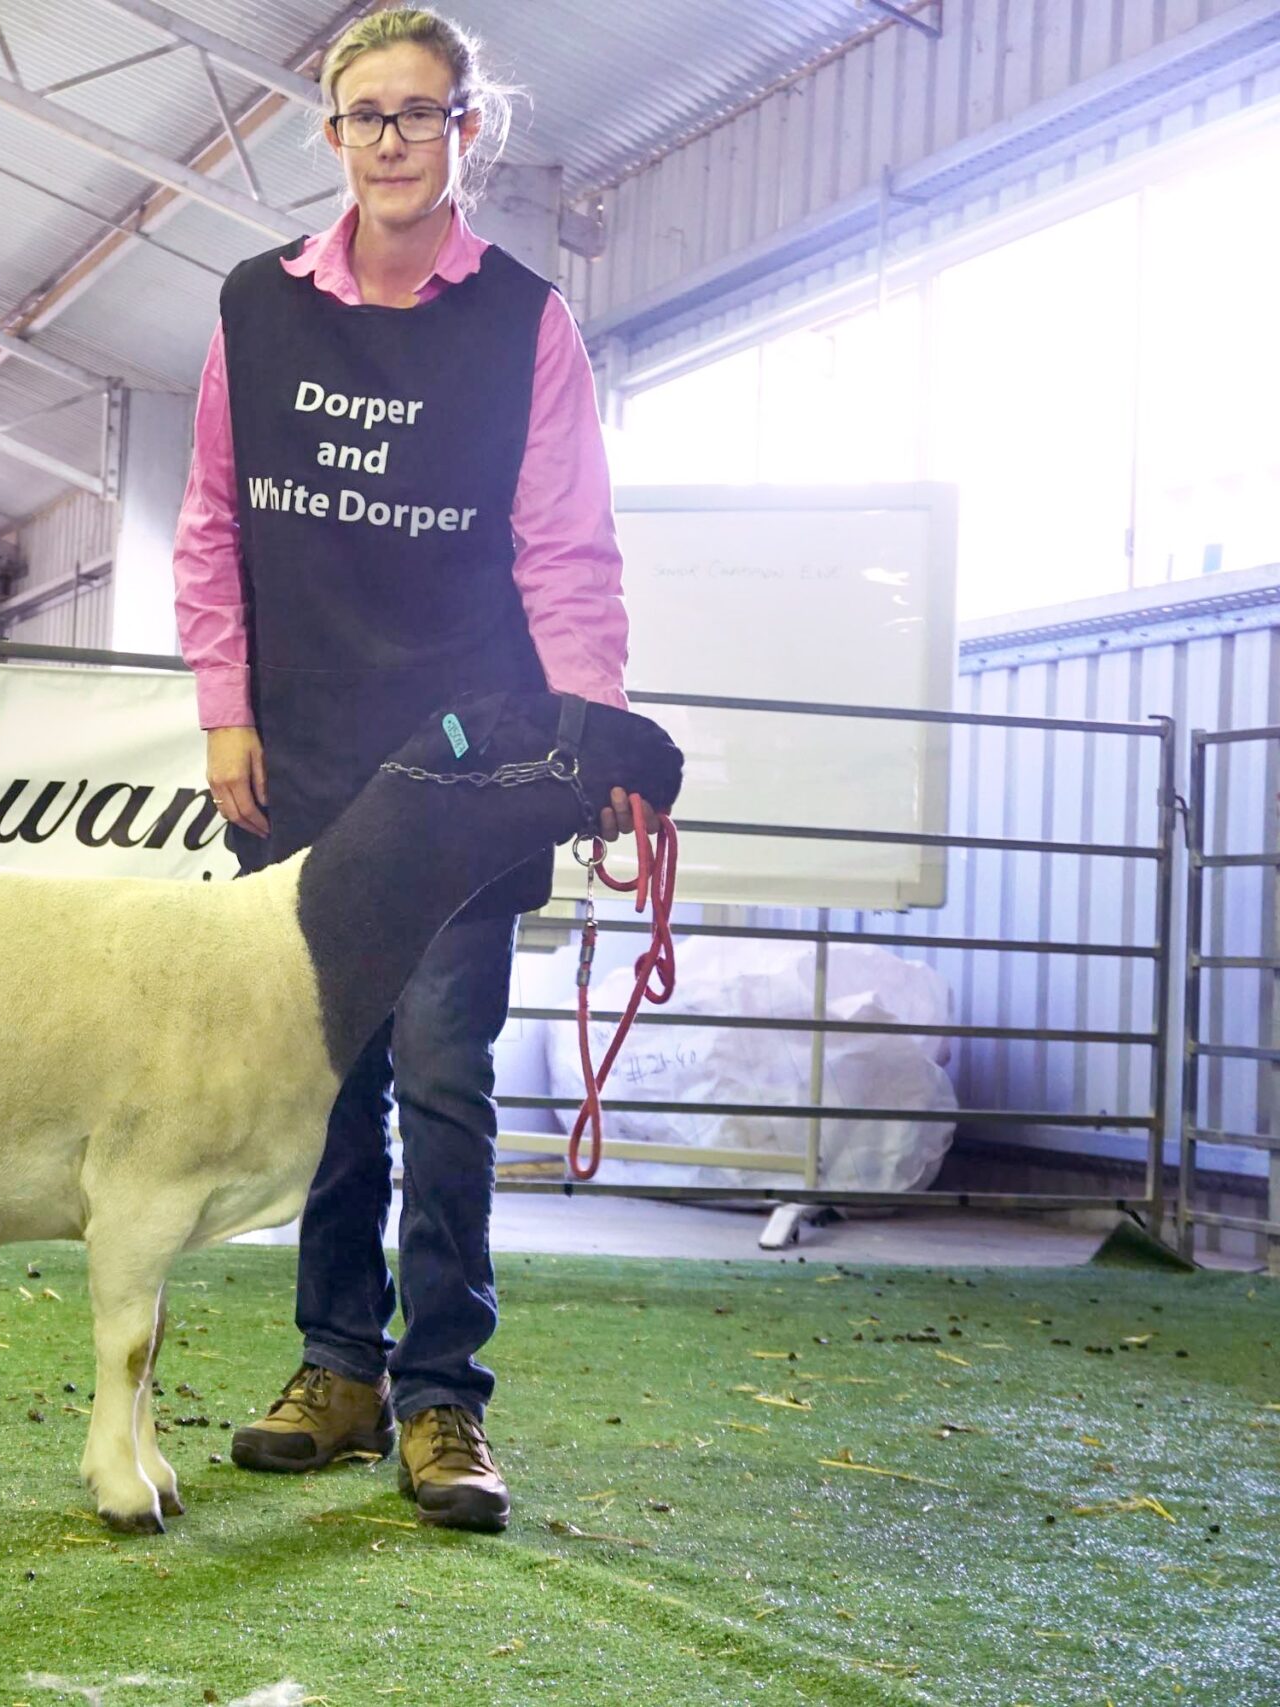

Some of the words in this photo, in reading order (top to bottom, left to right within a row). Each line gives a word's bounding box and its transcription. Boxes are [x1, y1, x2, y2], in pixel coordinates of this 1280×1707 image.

[294, 381, 423, 430] Dorper
[316, 441, 389, 474] and
[248, 477, 330, 517] White
[337, 489, 477, 537] Dorper
